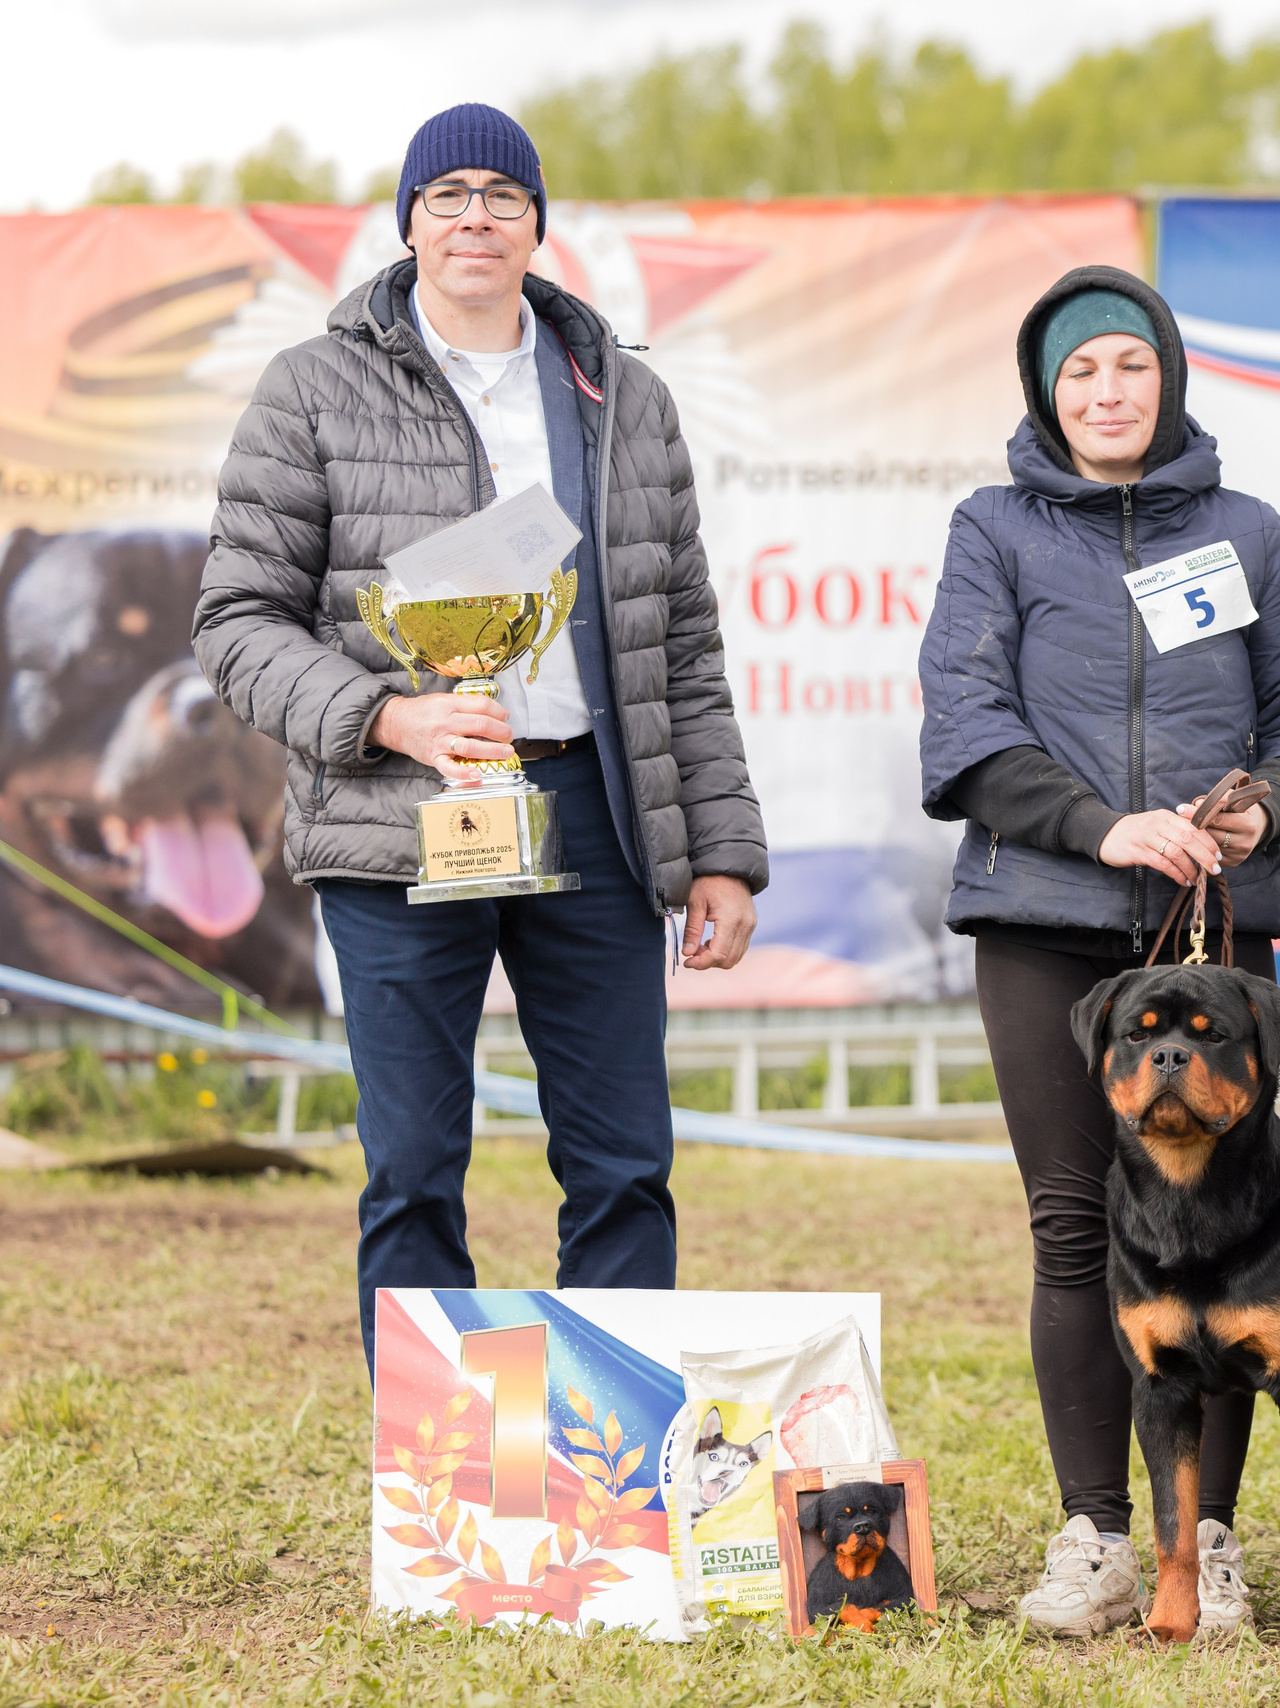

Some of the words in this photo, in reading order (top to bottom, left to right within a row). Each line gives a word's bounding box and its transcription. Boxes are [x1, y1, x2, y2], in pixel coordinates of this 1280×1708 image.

[1192, 547, 1230, 565] STATERA
[1184, 587, 1215, 628] 5
[454, 847, 495, 857] ПРИВОЛЖЬЯ
[444, 857, 475, 869] ЛУЧШИЙ
[476, 856, 502, 866] ЩЕНОК
[474, 866, 496, 874] Новгород
[460, 1320, 549, 1520] 1
[717, 1544, 778, 1564] STATE
[717, 1565, 741, 1574] 100%
[745, 1561, 778, 1571] BALAN
[492, 1594, 533, 1603] место
[737, 1595, 756, 1604] ДЛЯ
[757, 1593, 783, 1601] ВЗРОС
